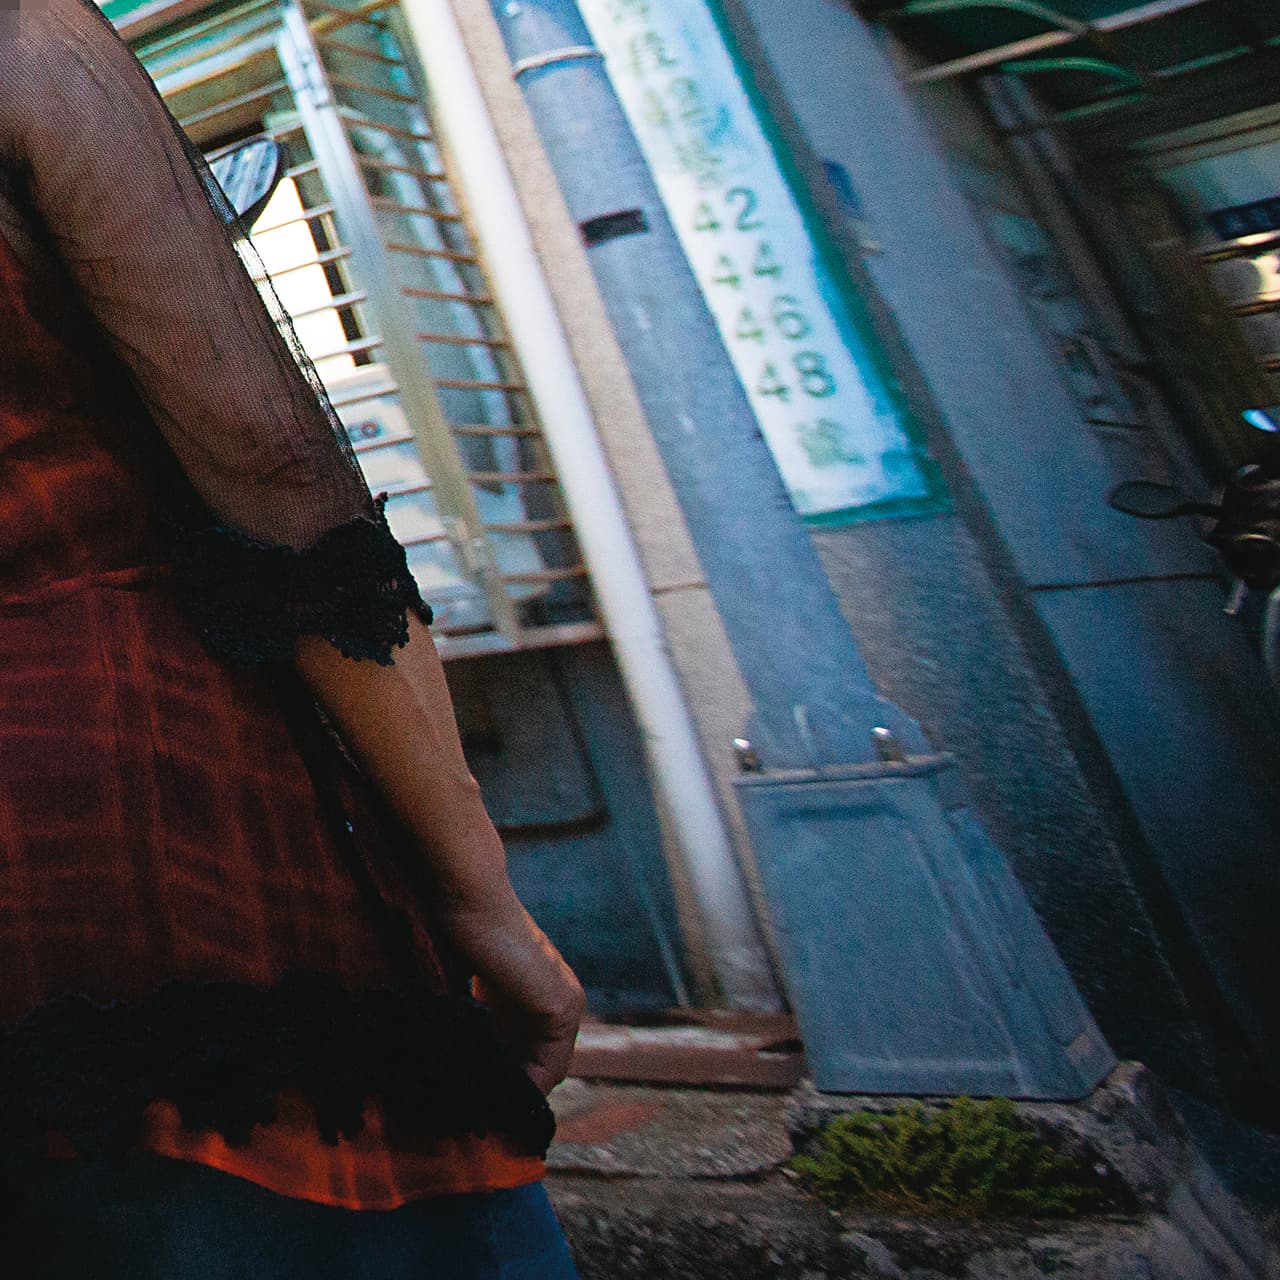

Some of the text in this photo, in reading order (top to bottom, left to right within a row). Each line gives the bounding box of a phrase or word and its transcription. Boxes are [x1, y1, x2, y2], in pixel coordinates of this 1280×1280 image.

[693, 186, 764, 233] 42
[712, 241, 782, 290] 44
[735, 294, 811, 345] 46
[757, 350, 837, 404] 48
